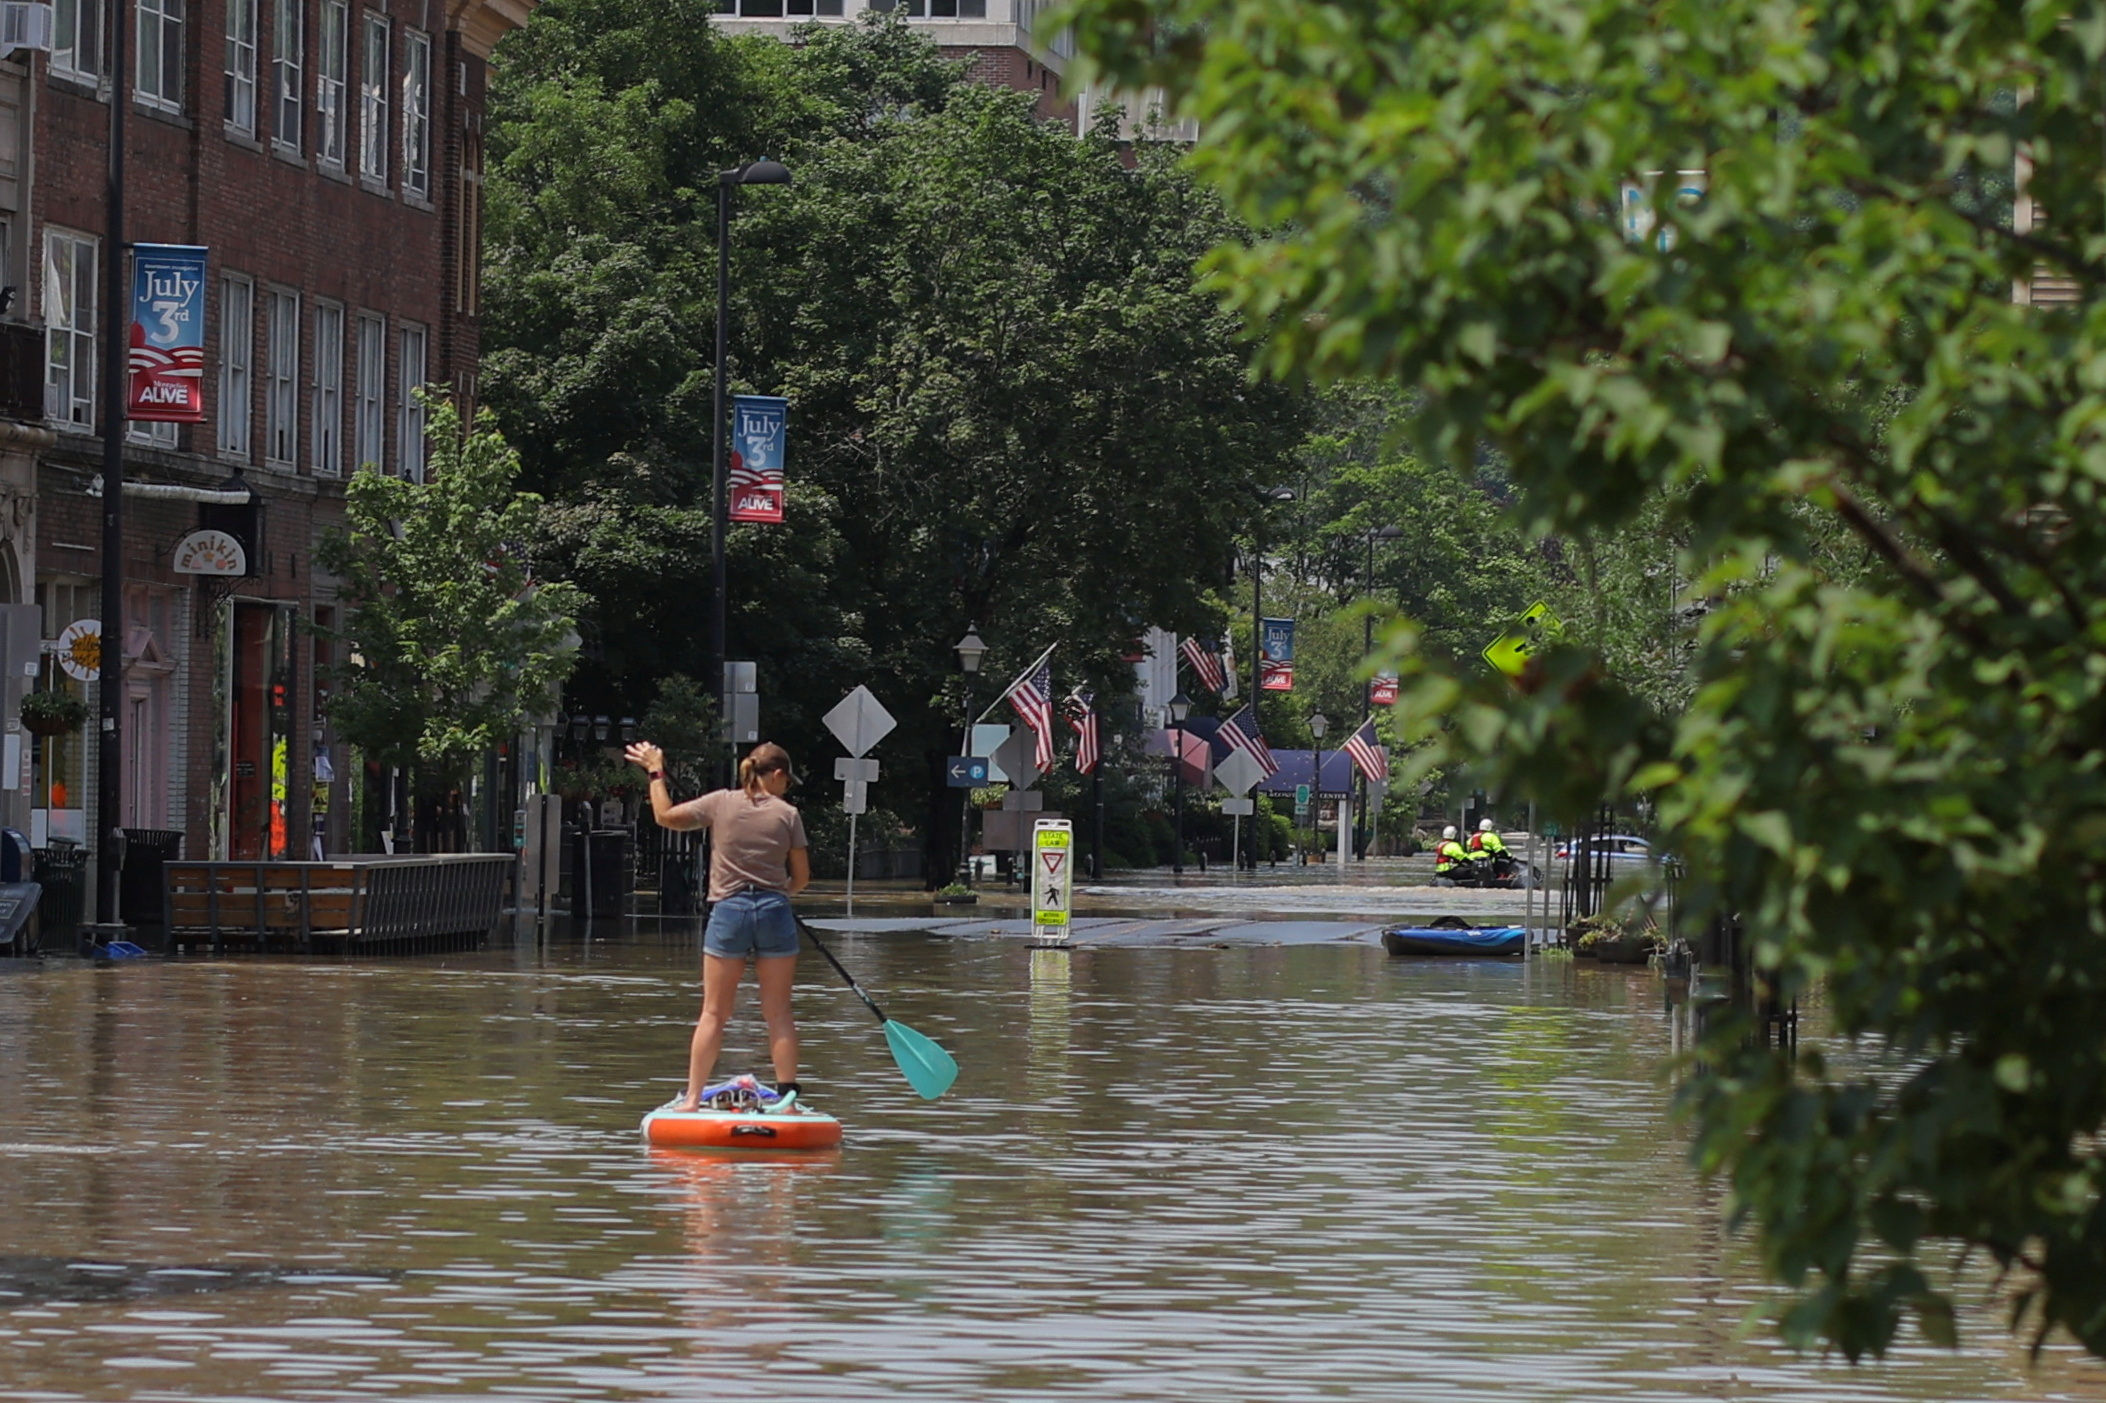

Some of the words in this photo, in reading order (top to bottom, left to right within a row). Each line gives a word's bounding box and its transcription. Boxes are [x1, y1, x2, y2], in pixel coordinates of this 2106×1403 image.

[138, 270, 200, 307] July
[150, 300, 190, 344] 3rd
[138, 386, 188, 404] ALIVE
[738, 415, 780, 441] July
[746, 436, 774, 467] 3rd
[738, 497, 773, 511] ALIVE
[181, 535, 237, 570] minikin
[1265, 628, 1290, 644] July
